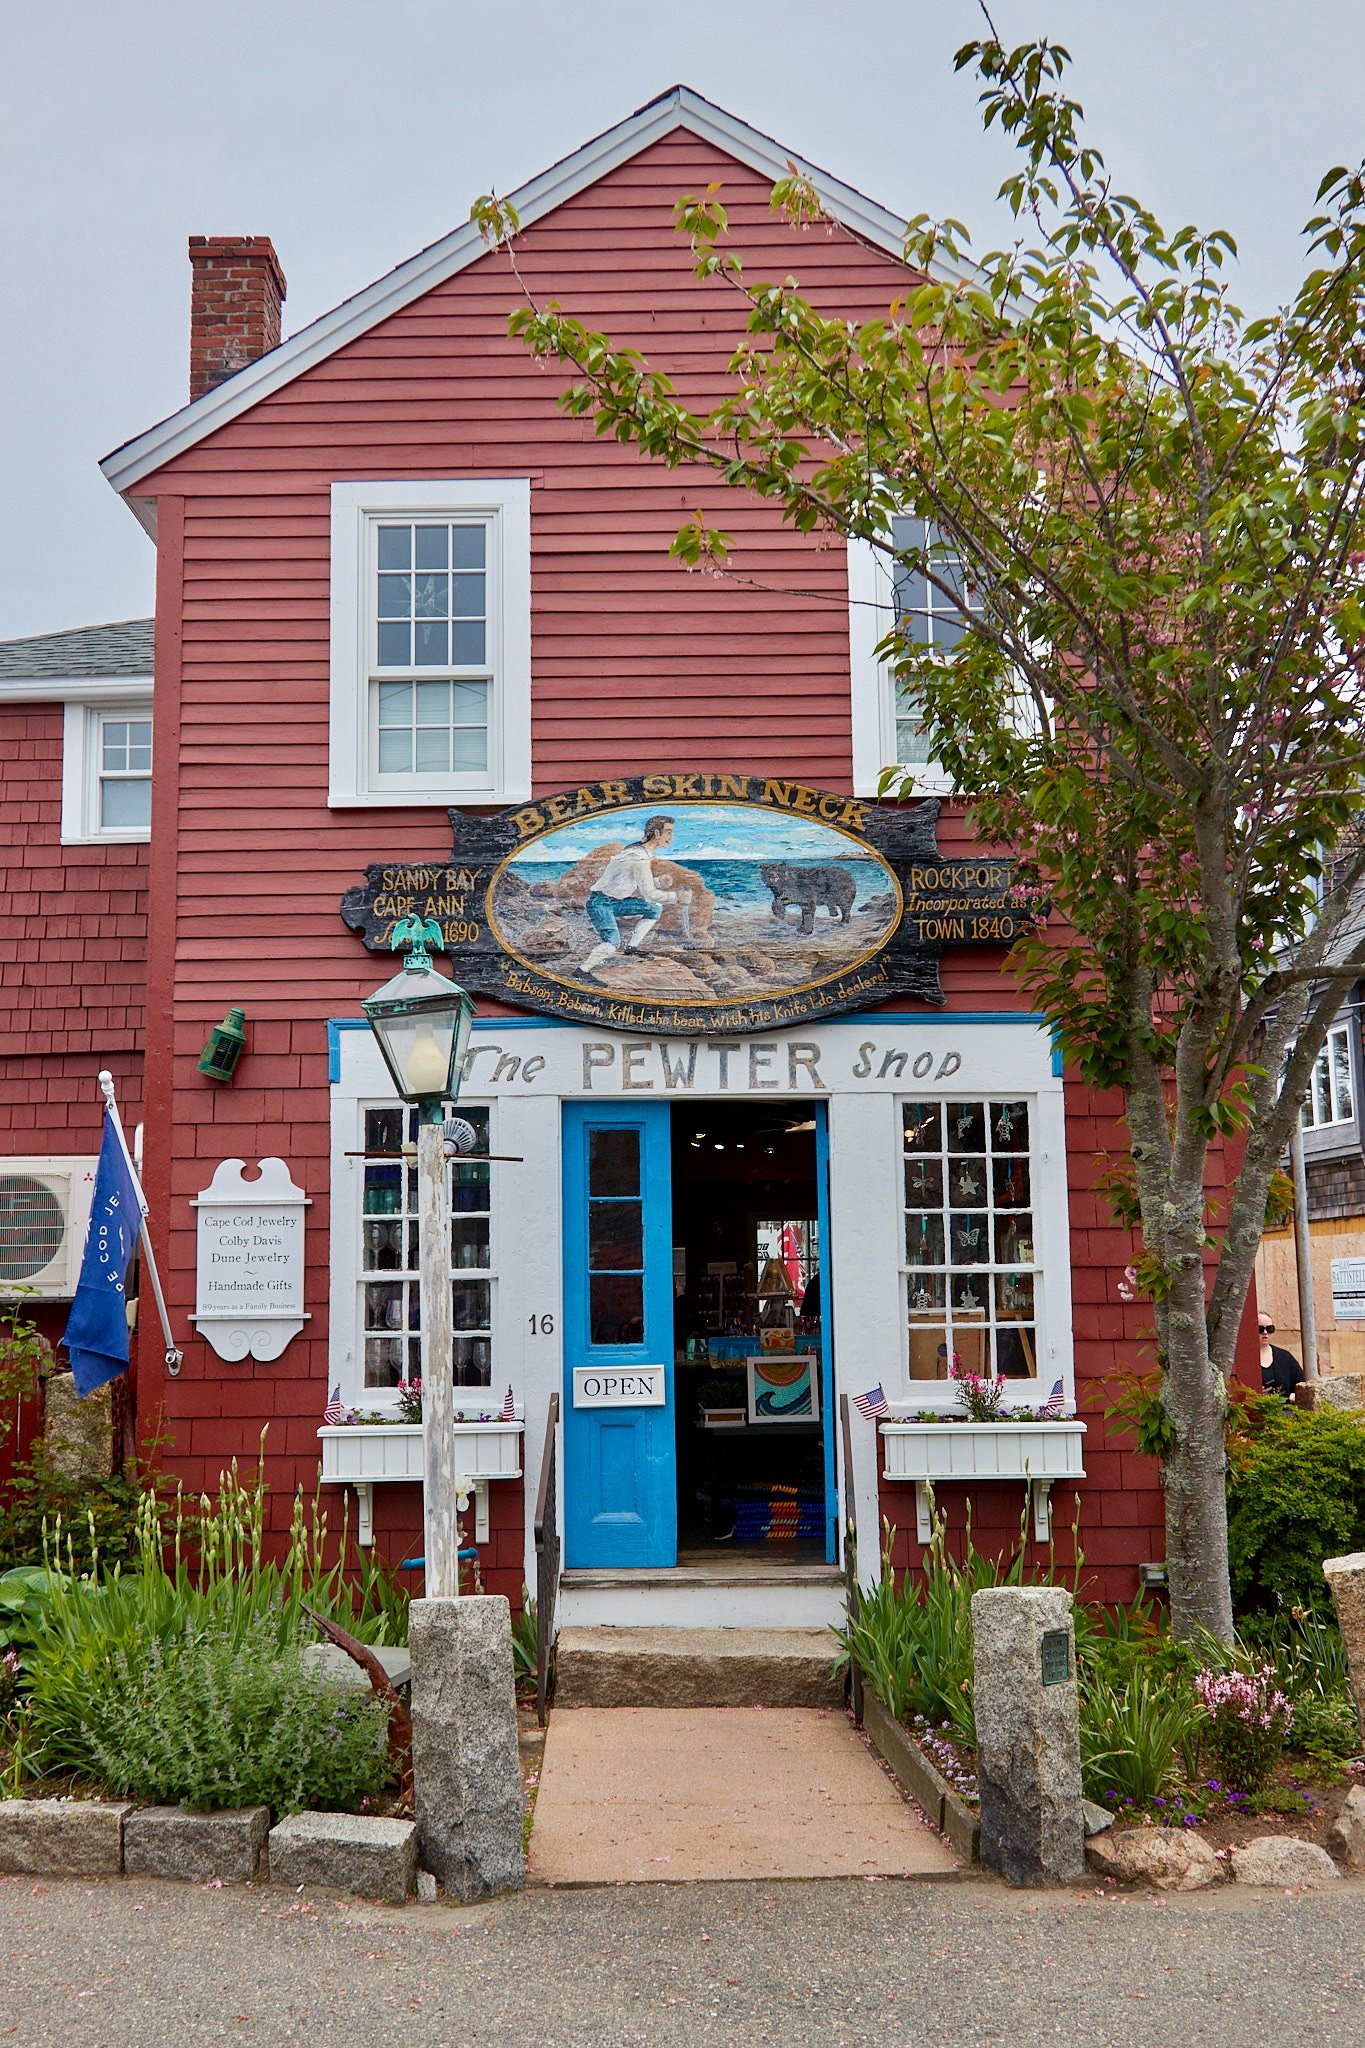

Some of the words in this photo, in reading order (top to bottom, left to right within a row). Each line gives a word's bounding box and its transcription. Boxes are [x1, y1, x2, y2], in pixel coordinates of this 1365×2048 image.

[508, 780, 632, 838] BEAR
[643, 774, 750, 799] SKIN
[760, 778, 873, 832] NECK
[382, 869, 443, 891] SANDY
[446, 869, 483, 892] BAY
[424, 895, 465, 916] ANN
[906, 891, 1009, 917] Incorporated
[1011, 896, 1027, 909] as
[443, 921, 479, 943] 1690
[913, 919, 964, 941] TOWN
[971, 917, 1014, 940] 1840
[608, 1003, 645, 1025] Killed
[649, 1009, 669, 1026] the
[711, 1010, 748, 1028] with
[750, 1008, 771, 1024] his
[774, 1003, 808, 1020] Knife
[818, 992, 835, 1008] do
[582, 1042, 827, 1090] PEWTER
[204, 1216, 230, 1228] Cape
[232, 1216, 254, 1227] Cod
[256, 1216, 297, 1227] Jewelry
[98, 1225, 110, 1263] COD
[219, 1235, 250, 1248] Colby
[253, 1235, 282, 1246] Davis
[211, 1252, 242, 1263] Dune
[244, 1252, 290, 1265] Jewelry
[208, 1281, 264, 1291] Handmade
[267, 1280, 293, 1291] Gifts
[245, 1302, 268, 1311] Family
[269, 1302, 296, 1310] Business
[528, 1314, 554, 1335] 16
[584, 1377, 654, 1396] OPEN
